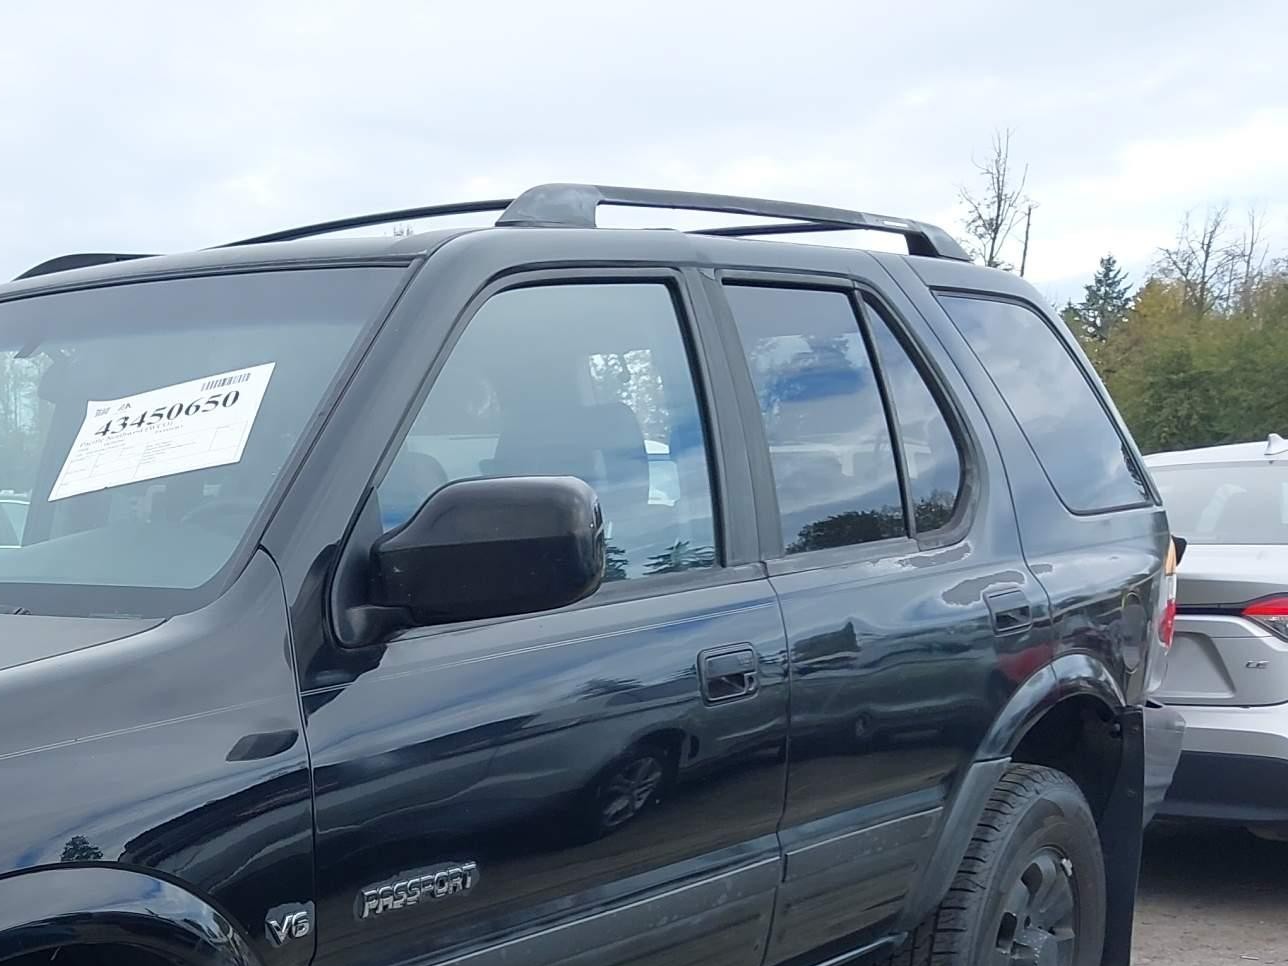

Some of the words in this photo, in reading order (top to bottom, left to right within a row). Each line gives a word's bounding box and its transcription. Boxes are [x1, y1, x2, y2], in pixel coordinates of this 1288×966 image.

[96, 391, 239, 436] 43450650
[362, 863, 476, 918] PASSPORT
[268, 911, 310, 945] V6
